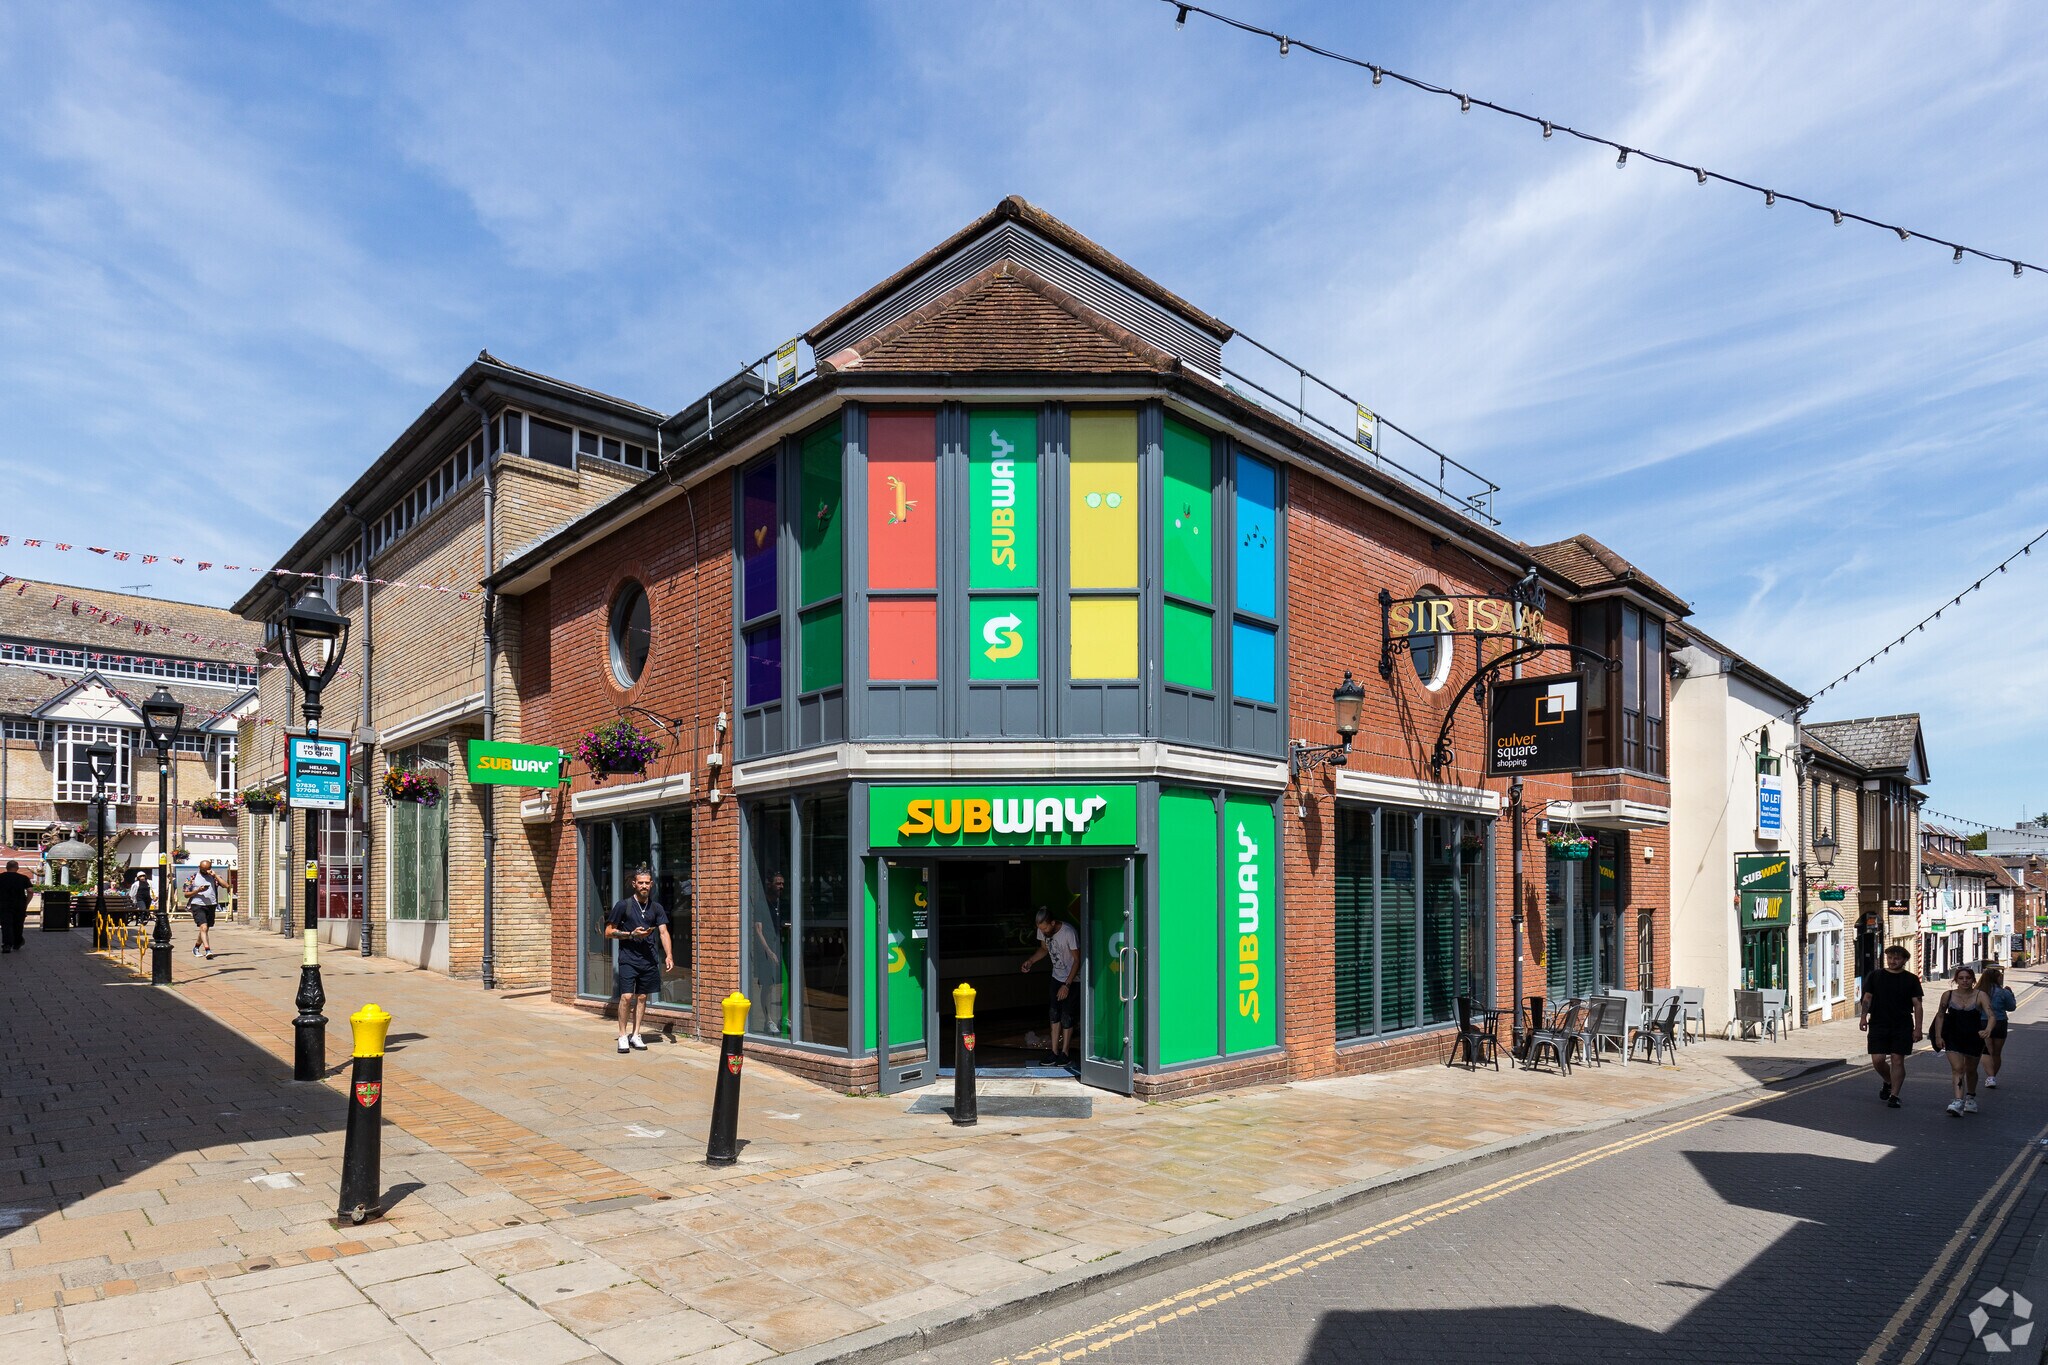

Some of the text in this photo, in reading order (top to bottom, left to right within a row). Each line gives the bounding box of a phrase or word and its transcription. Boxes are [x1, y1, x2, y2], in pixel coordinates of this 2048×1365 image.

[989, 428, 1017, 572] SUBWAY
[1390, 600, 1456, 635] SIR
[1497, 732, 1537, 748] culver
[477, 756, 553, 773] SUBWAY
[1497, 745, 1538, 760] square
[1497, 759, 1528, 768] shopping
[1761, 793, 1780, 804] TO LET
[897, 794, 1107, 838] SUBWAY
[1741, 860, 1787, 887] SUBWAY
[1753, 896, 1783, 920] SUBWAY
[1236, 821, 1260, 1024] SUBWAY
